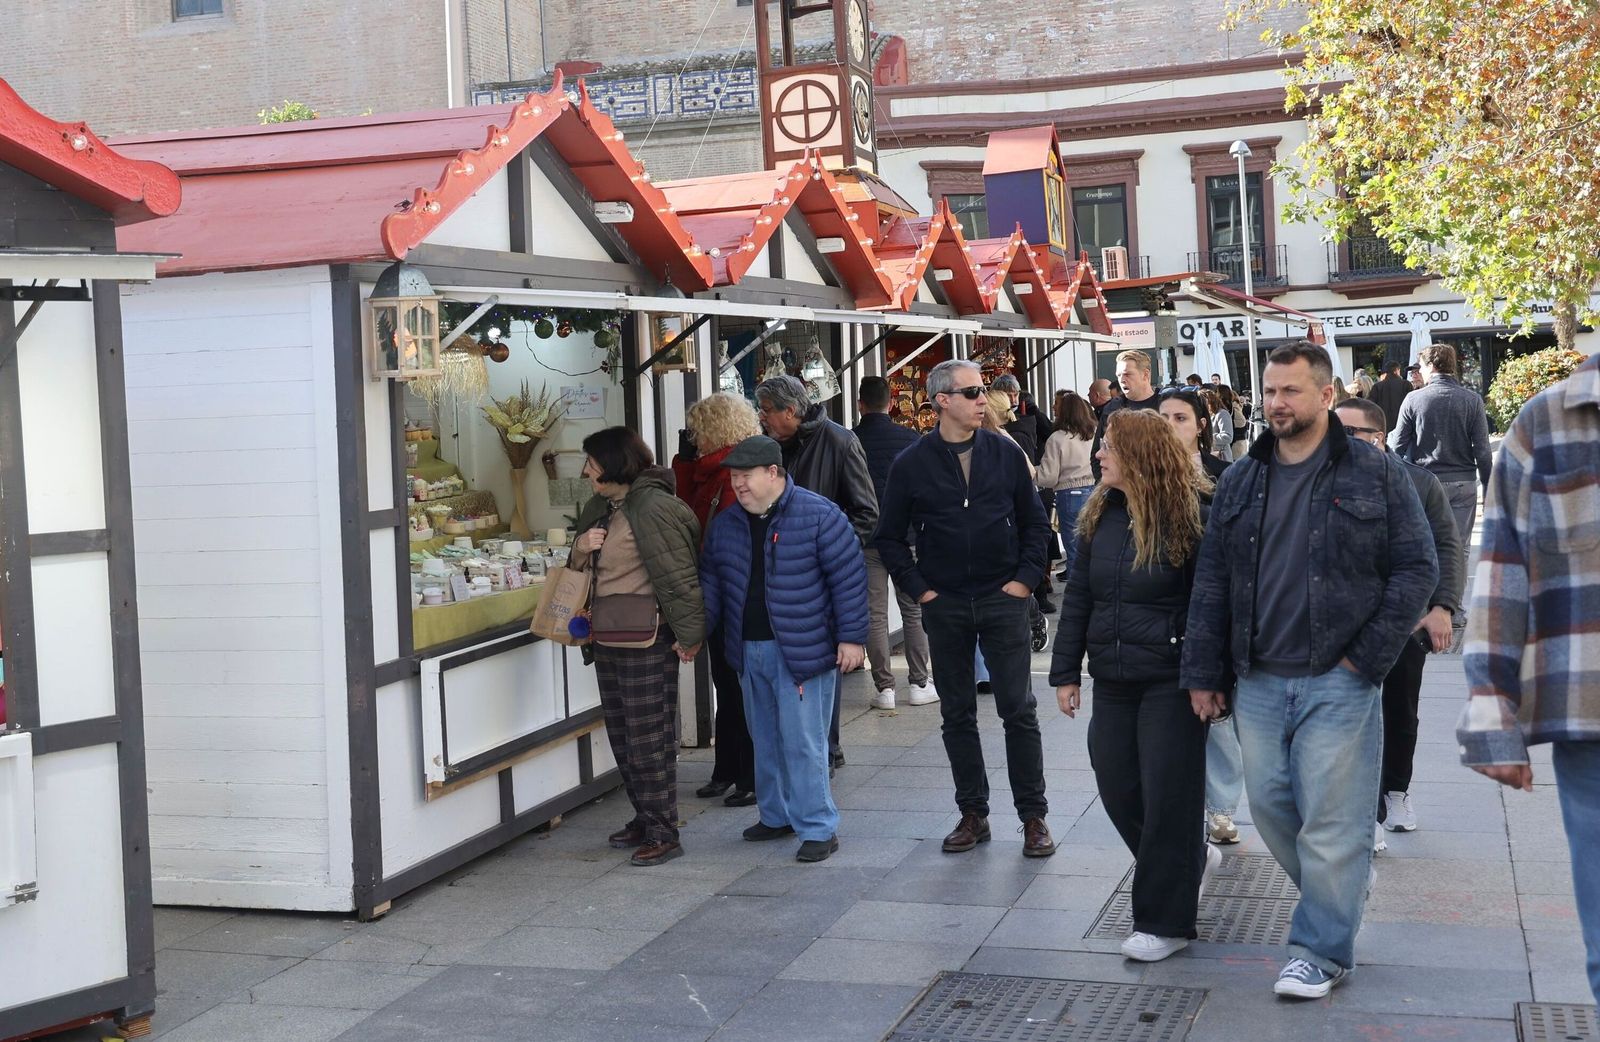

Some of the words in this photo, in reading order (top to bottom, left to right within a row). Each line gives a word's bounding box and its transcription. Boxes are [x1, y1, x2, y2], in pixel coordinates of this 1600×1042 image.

[1356, 313, 1393, 327] CAKE
[1397, 312, 1409, 324] &
[1124, 328, 1149, 337] Estado
